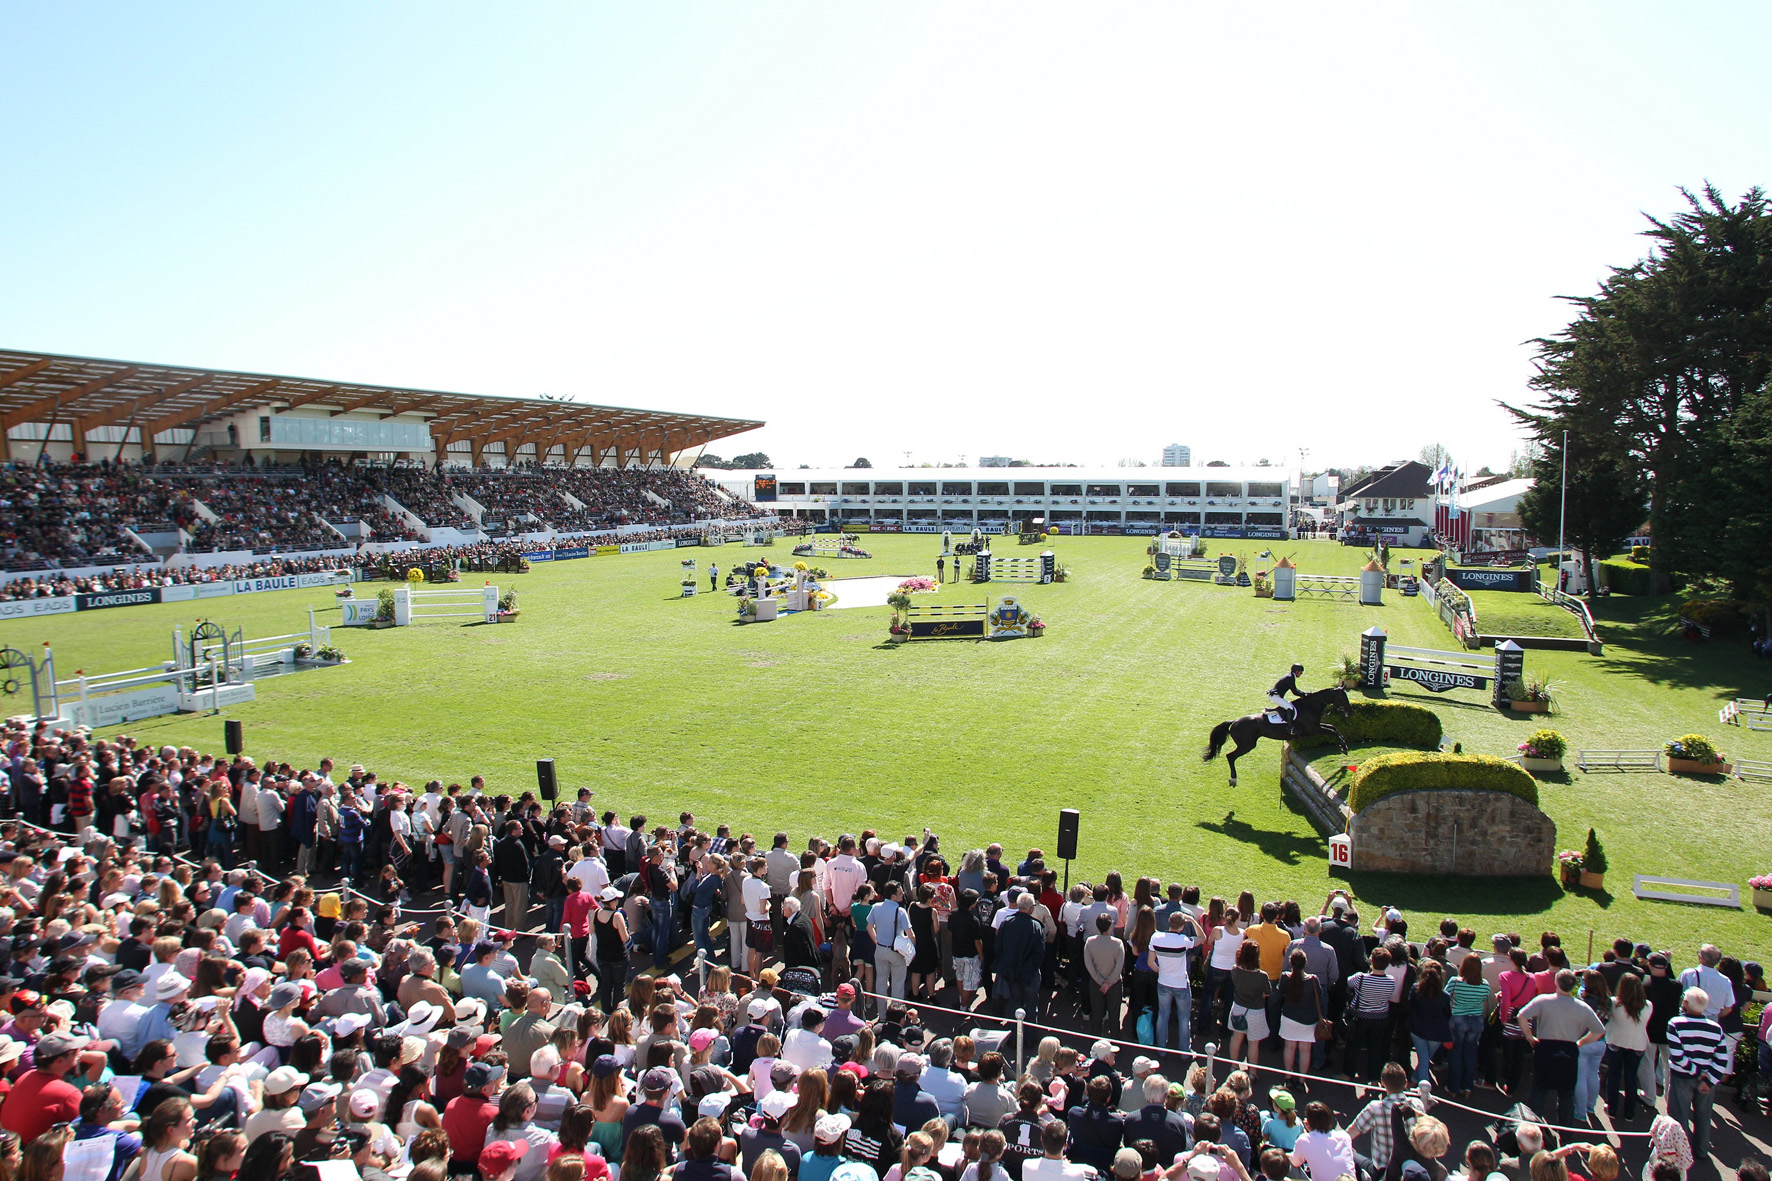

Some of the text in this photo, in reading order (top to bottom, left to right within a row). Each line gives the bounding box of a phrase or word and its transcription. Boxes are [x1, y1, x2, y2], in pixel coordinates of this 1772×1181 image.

[301, 577, 325, 585] EADS
[1462, 573, 1514, 581] LONGINES
[236, 581, 252, 593] LA
[255, 577, 296, 591] BAULE
[34, 600, 71, 612] EADS
[86, 592, 152, 608] LONGINES
[488, 613, 496, 621] 21
[1367, 640, 1377, 686] LONGINES
[1383, 671, 1389, 683] 9
[1399, 667, 1475, 688] LONGINES
[1330, 843, 1348, 862] 16
[1017, 1123, 1031, 1147] 1
[1007, 1143, 1044, 1156] PORTS
